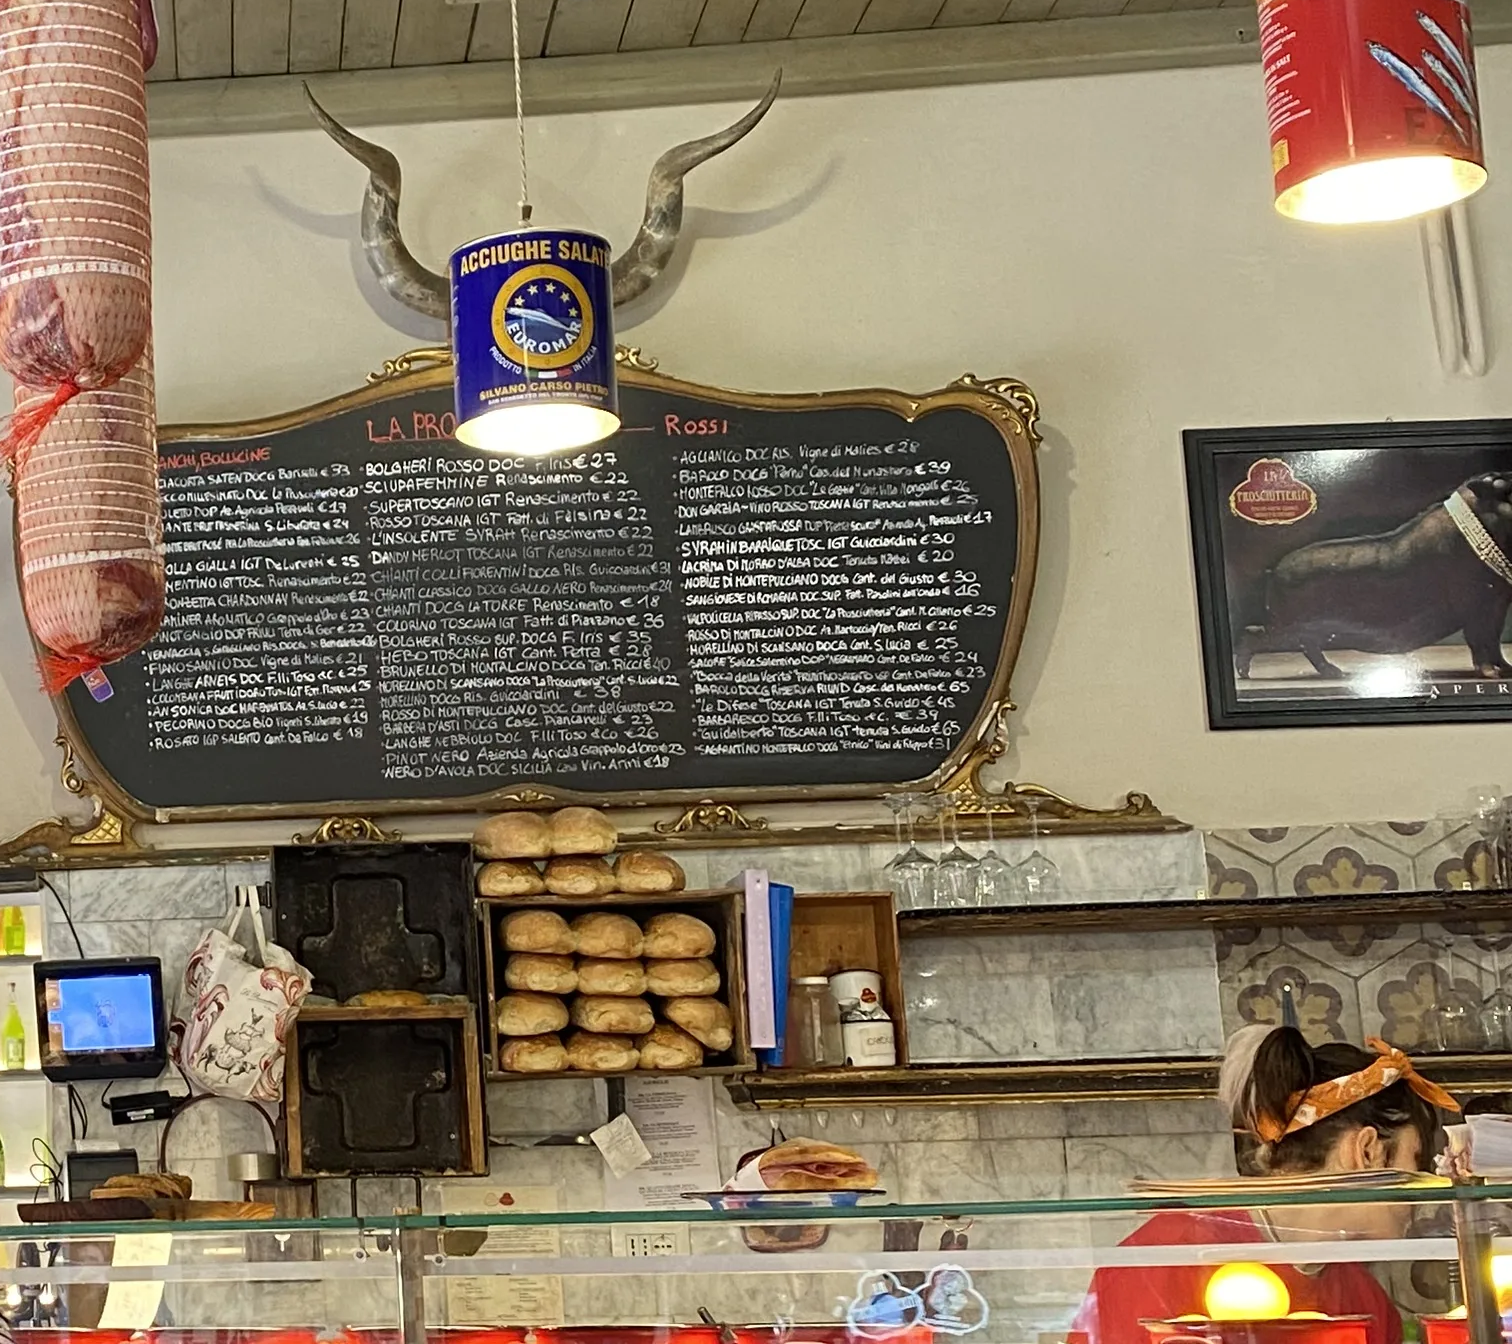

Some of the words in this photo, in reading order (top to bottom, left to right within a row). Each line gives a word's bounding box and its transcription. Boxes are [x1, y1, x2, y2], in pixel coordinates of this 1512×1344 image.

[460, 240, 552, 277] ACCIUGHE
[507, 319, 582, 355] EUROMAR
[489, 346, 522, 375] PRODOTTO
[479, 383, 526, 400] SILVANO
[530, 381, 572, 391] CARSO
[489, 457, 525, 471] DOC
[476, 494, 502, 507] IGT
[476, 512, 504, 526] IGT
[494, 645, 516, 659] IGT
